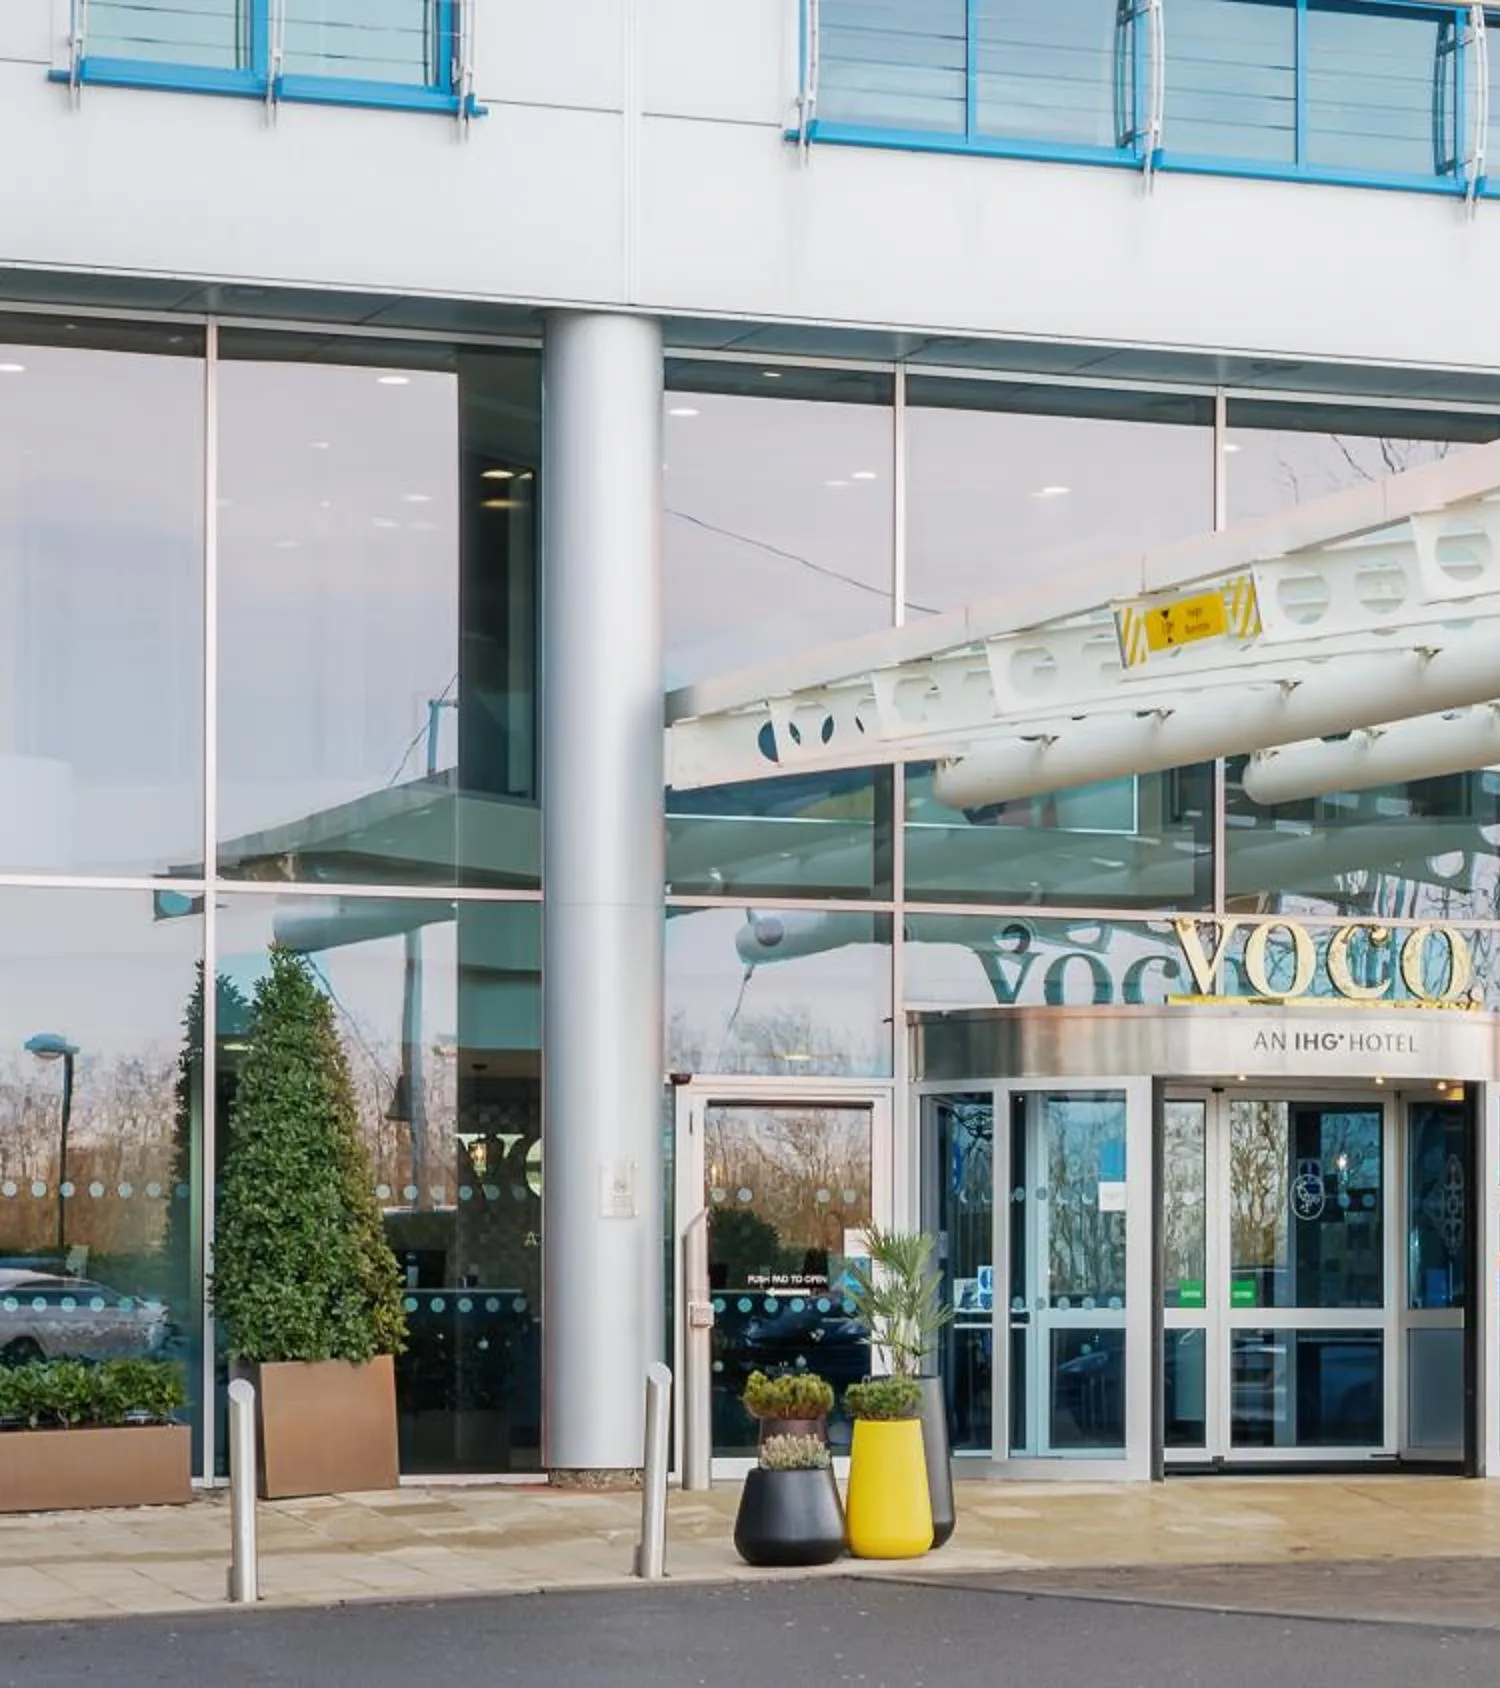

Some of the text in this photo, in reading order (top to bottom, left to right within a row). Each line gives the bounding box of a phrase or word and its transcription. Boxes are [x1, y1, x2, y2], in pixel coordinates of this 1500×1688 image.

[1253, 1030, 1287, 1052] AN
[1349, 1033, 1421, 1054] HOTEL
[790, 1274, 803, 1284] TO
